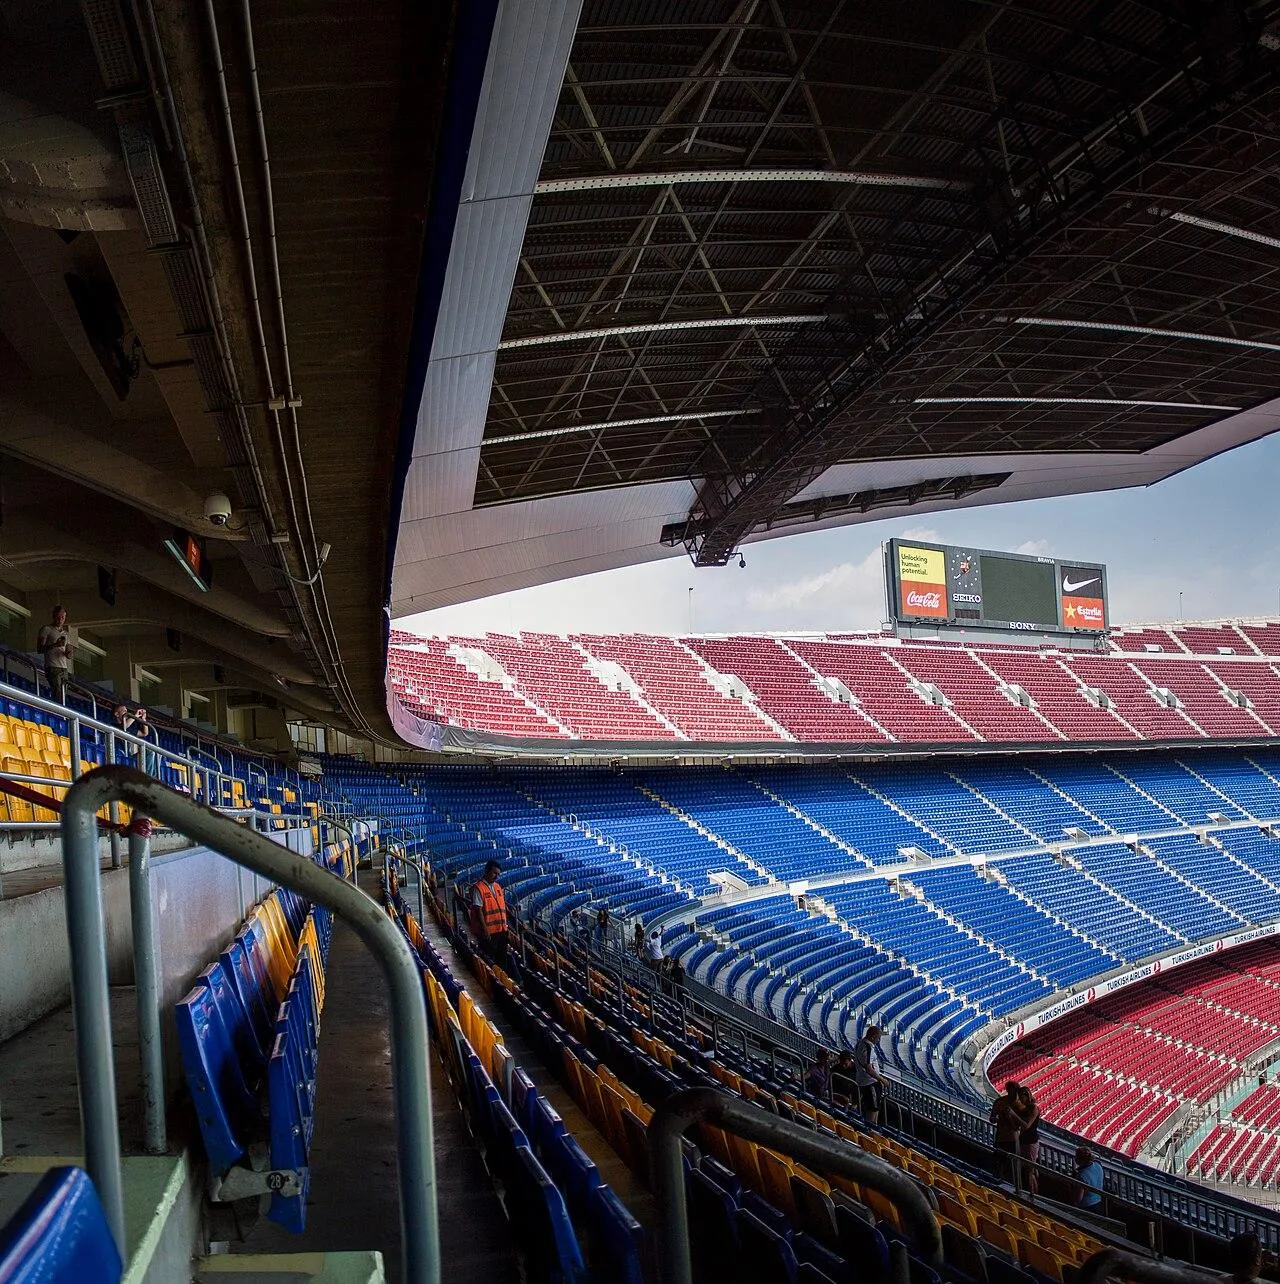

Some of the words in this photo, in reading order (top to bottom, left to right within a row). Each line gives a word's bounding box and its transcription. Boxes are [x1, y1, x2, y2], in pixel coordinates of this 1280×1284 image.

[901, 554, 928, 564] Unlocking
[902, 567, 928, 575] potential.
[952, 593, 981, 603] SEIKO
[1009, 622, 1036, 630] SONY
[1234, 931, 1255, 944] TURKISH
[1255, 926, 1276, 939] AIRLINES
[1172, 952, 1193, 965] TURKISH
[1194, 944, 1215, 958] AIRLINES
[1106, 976, 1129, 991] TURKISH
[1129, 967, 1152, 983] AIRLINES
[1038, 1007, 1061, 1023] TURKISH
[1061, 995, 1086, 1011] AIRLINES
[270, 1174, 281, 1189] 28
